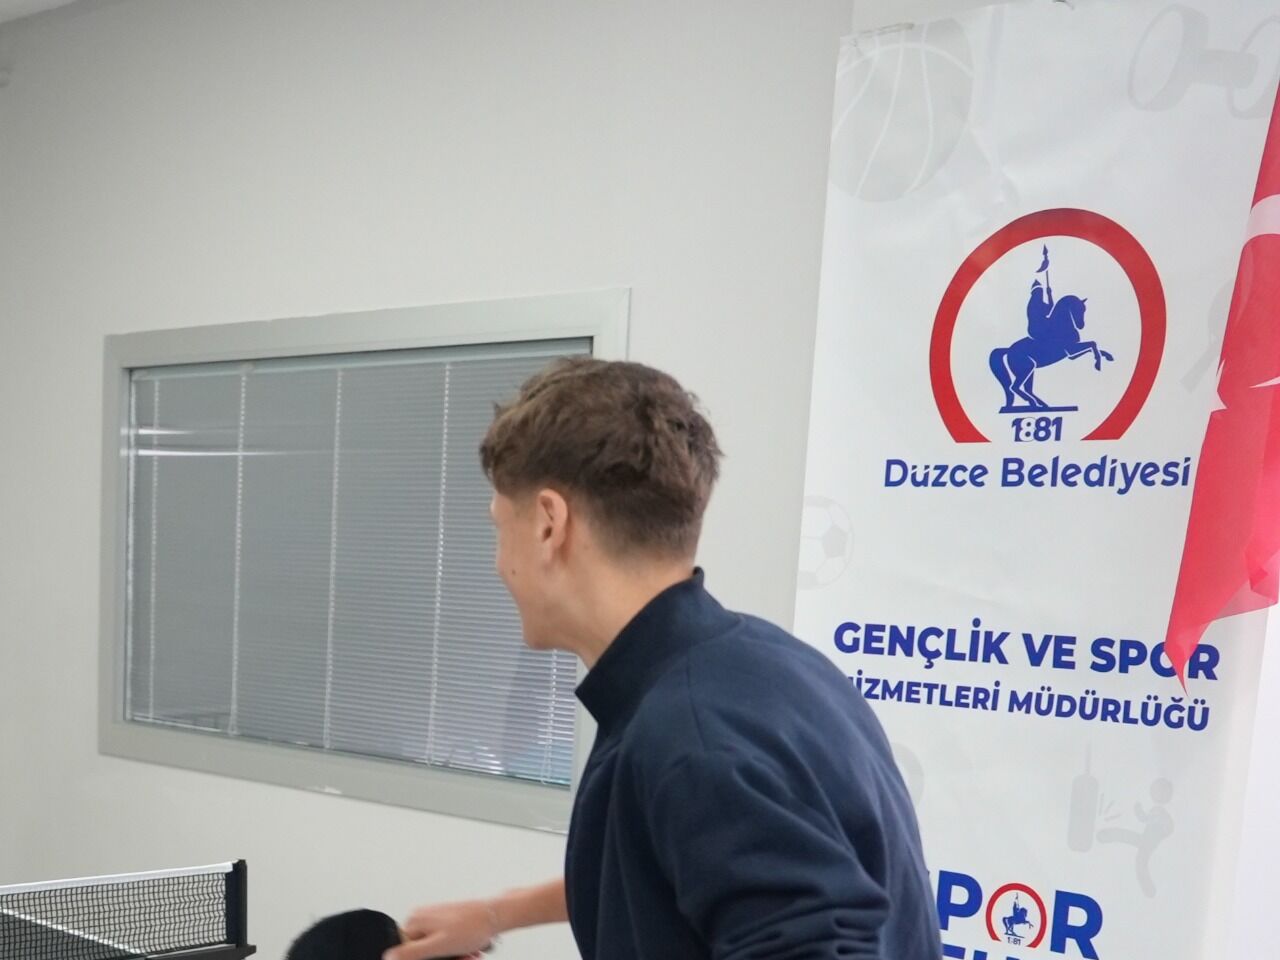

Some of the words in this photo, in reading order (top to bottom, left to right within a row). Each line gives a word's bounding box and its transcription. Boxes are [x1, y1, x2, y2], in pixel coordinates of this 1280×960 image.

[884, 458, 988, 488] Düzce
[1001, 455, 1191, 495] Belediyesi
[834, 617, 1011, 669] GENÇLİK
[1022, 632, 1077, 670] VE
[1090, 637, 1220, 680] SPOR
[848, 669, 1000, 711] İZMETLERİ
[1008, 685, 1210, 731] MÜDÜRLÜĞÜ
[936, 870, 1103, 960] POR
